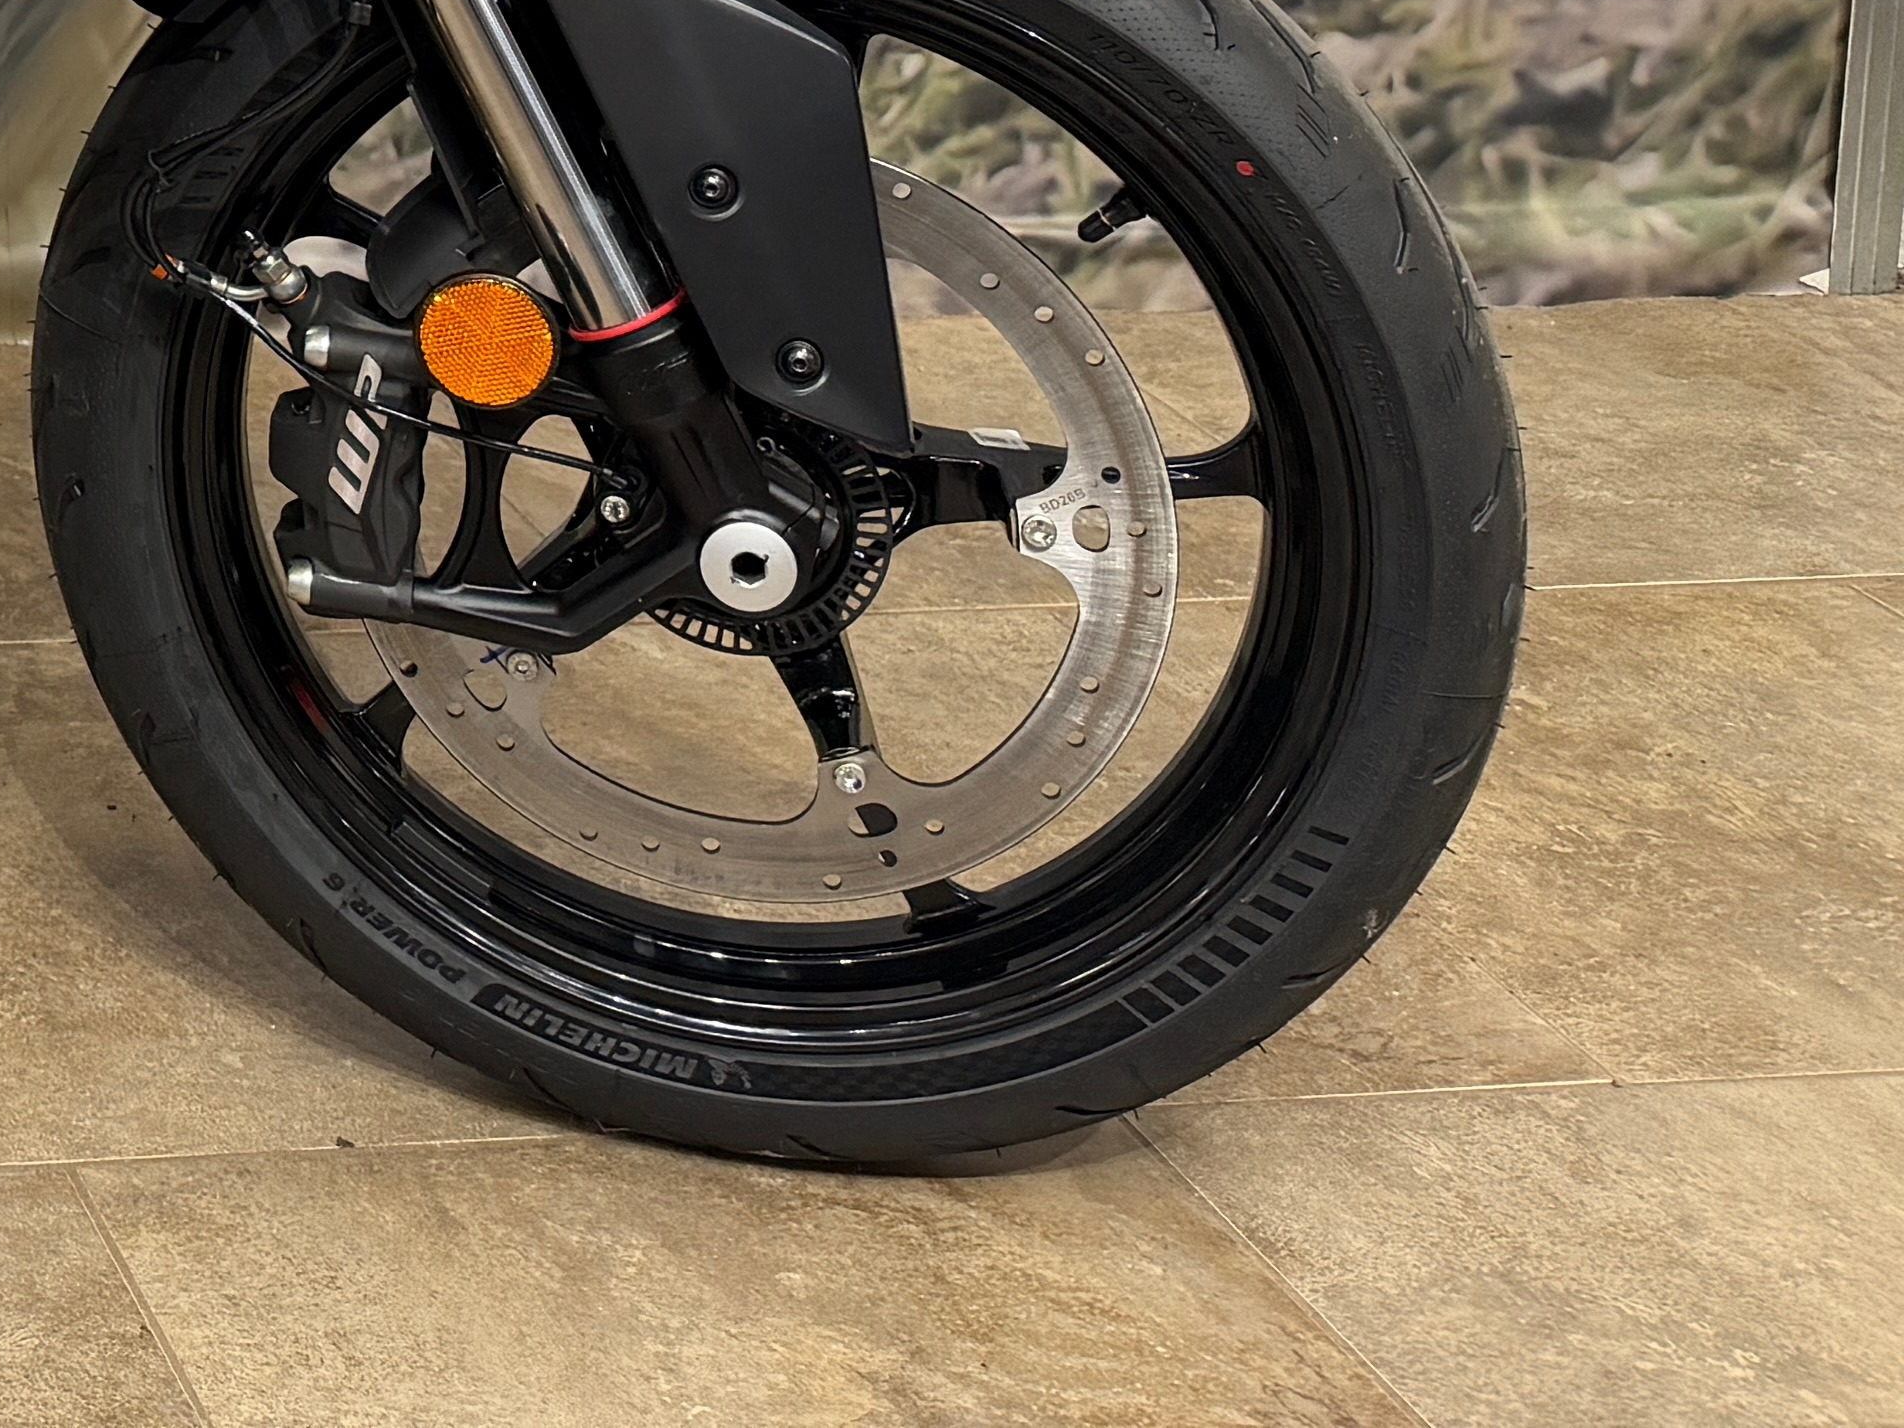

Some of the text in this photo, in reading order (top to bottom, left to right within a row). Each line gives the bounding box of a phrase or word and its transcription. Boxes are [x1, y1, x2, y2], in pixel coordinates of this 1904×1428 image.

[328, 353, 388, 515] WP
[348, 896, 468, 986] POWER
[493, 992, 699, 1079] MICHELIN
